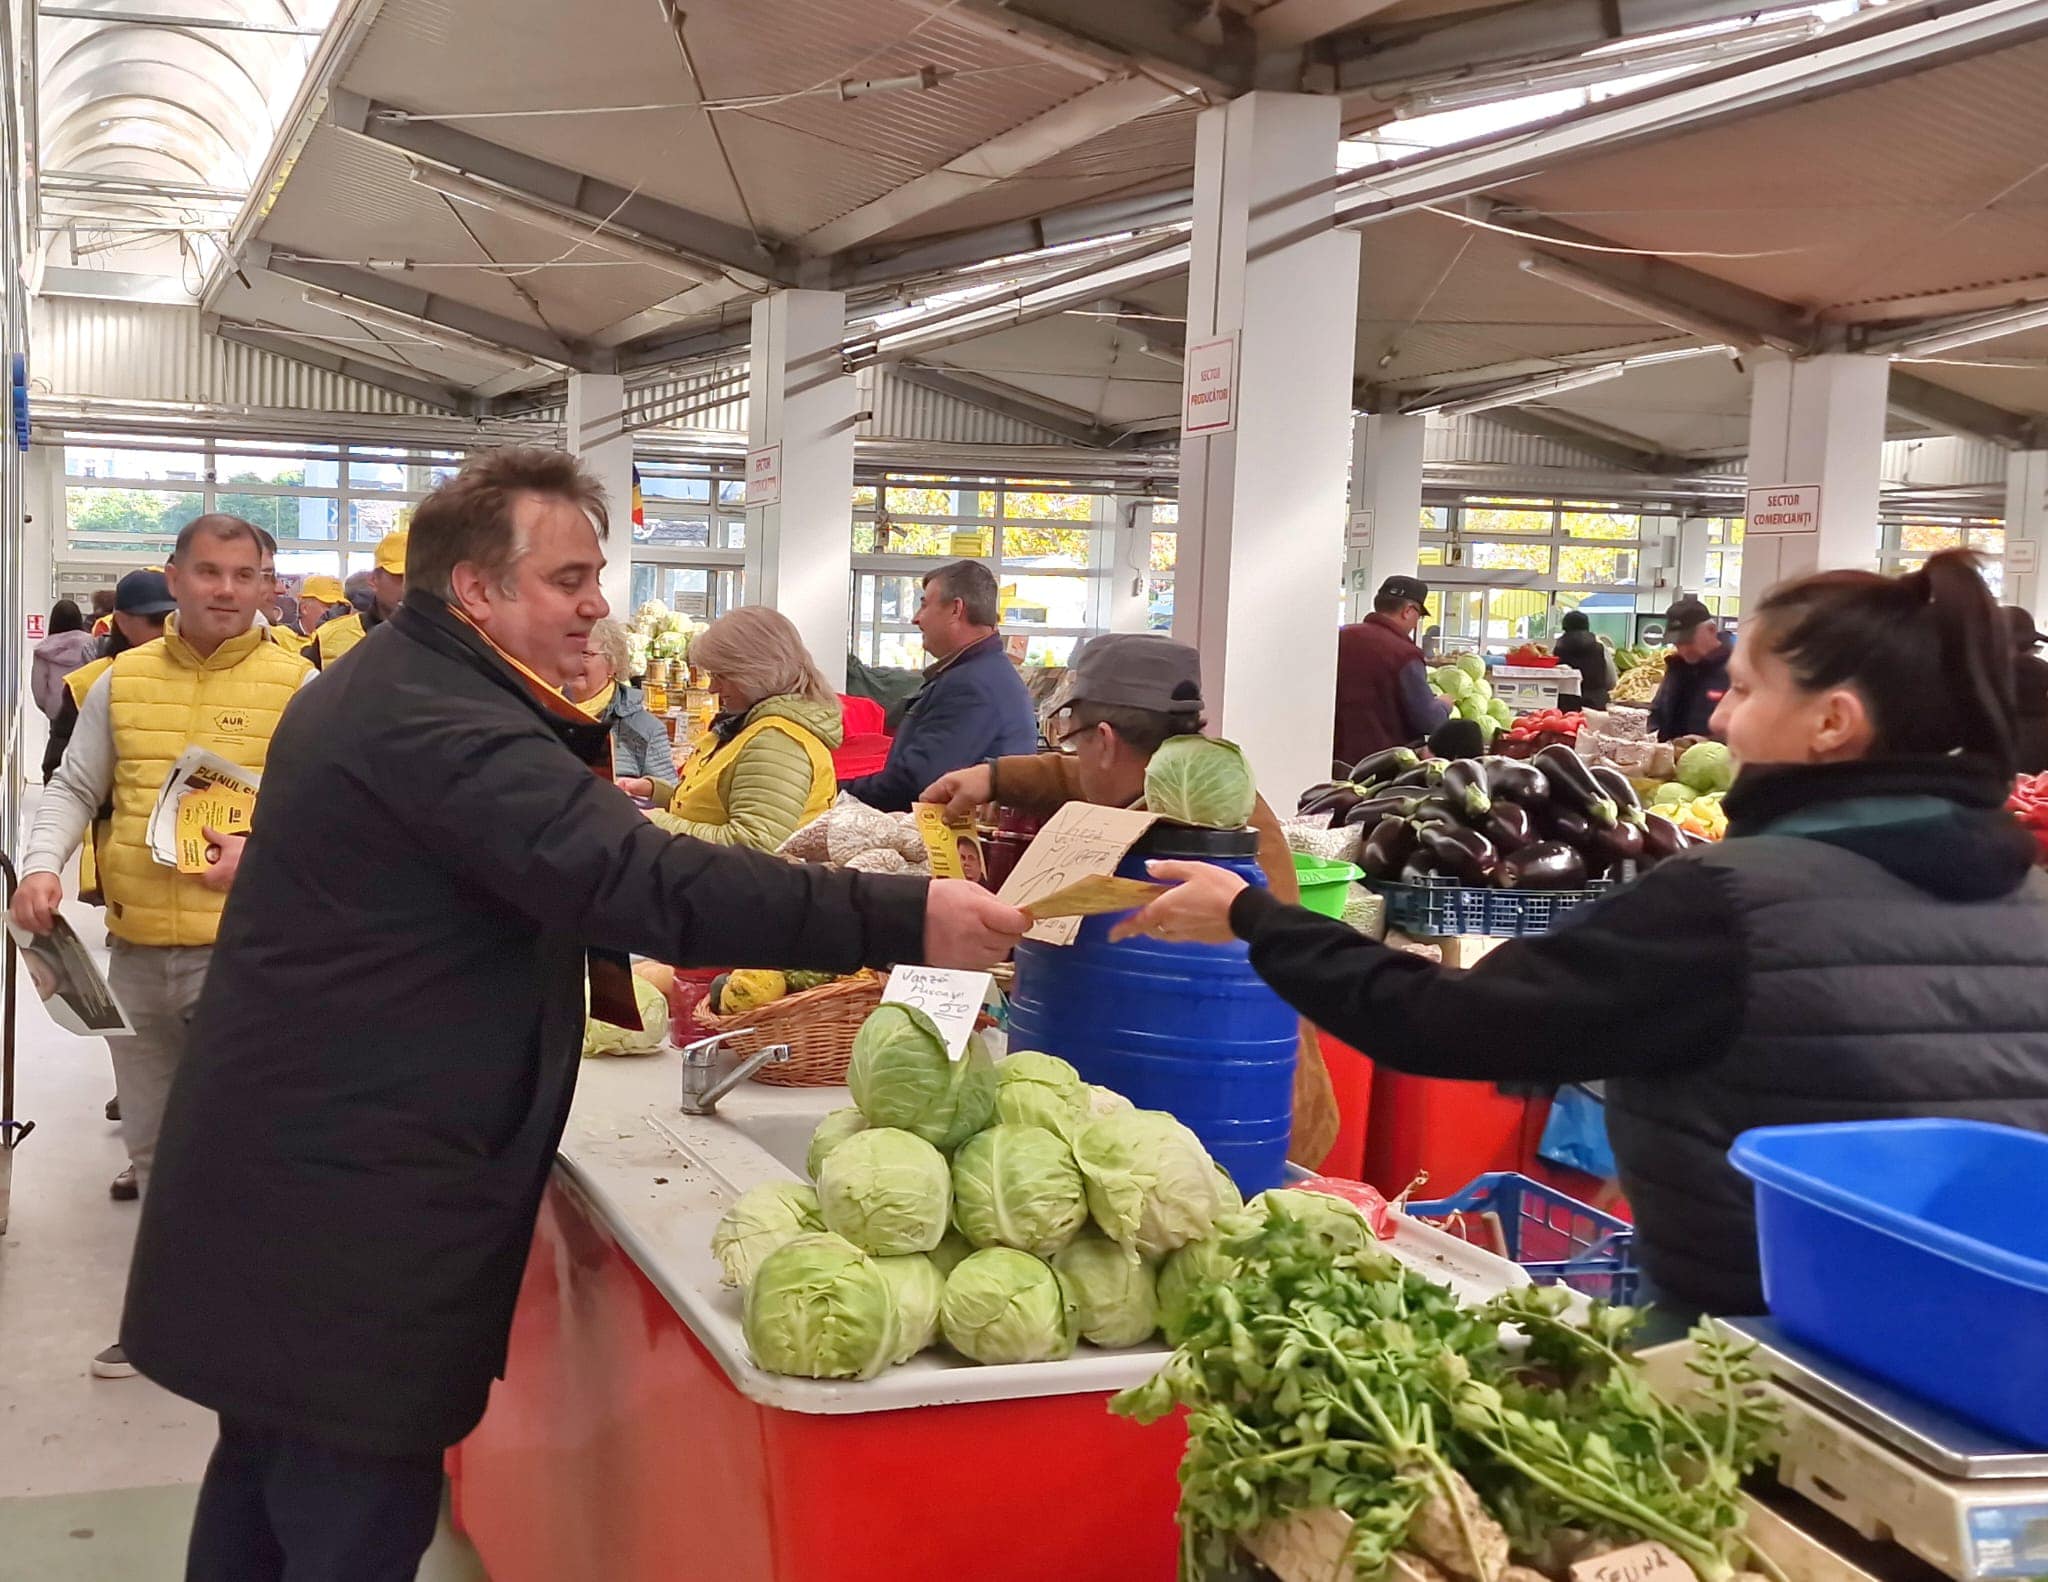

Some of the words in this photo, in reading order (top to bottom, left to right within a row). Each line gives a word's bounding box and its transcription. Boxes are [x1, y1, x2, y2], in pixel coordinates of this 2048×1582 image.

[1767, 494, 1800, 507] SECTOR
[221, 716, 243, 726] AUR
[194, 766, 240, 793] PLANUL
